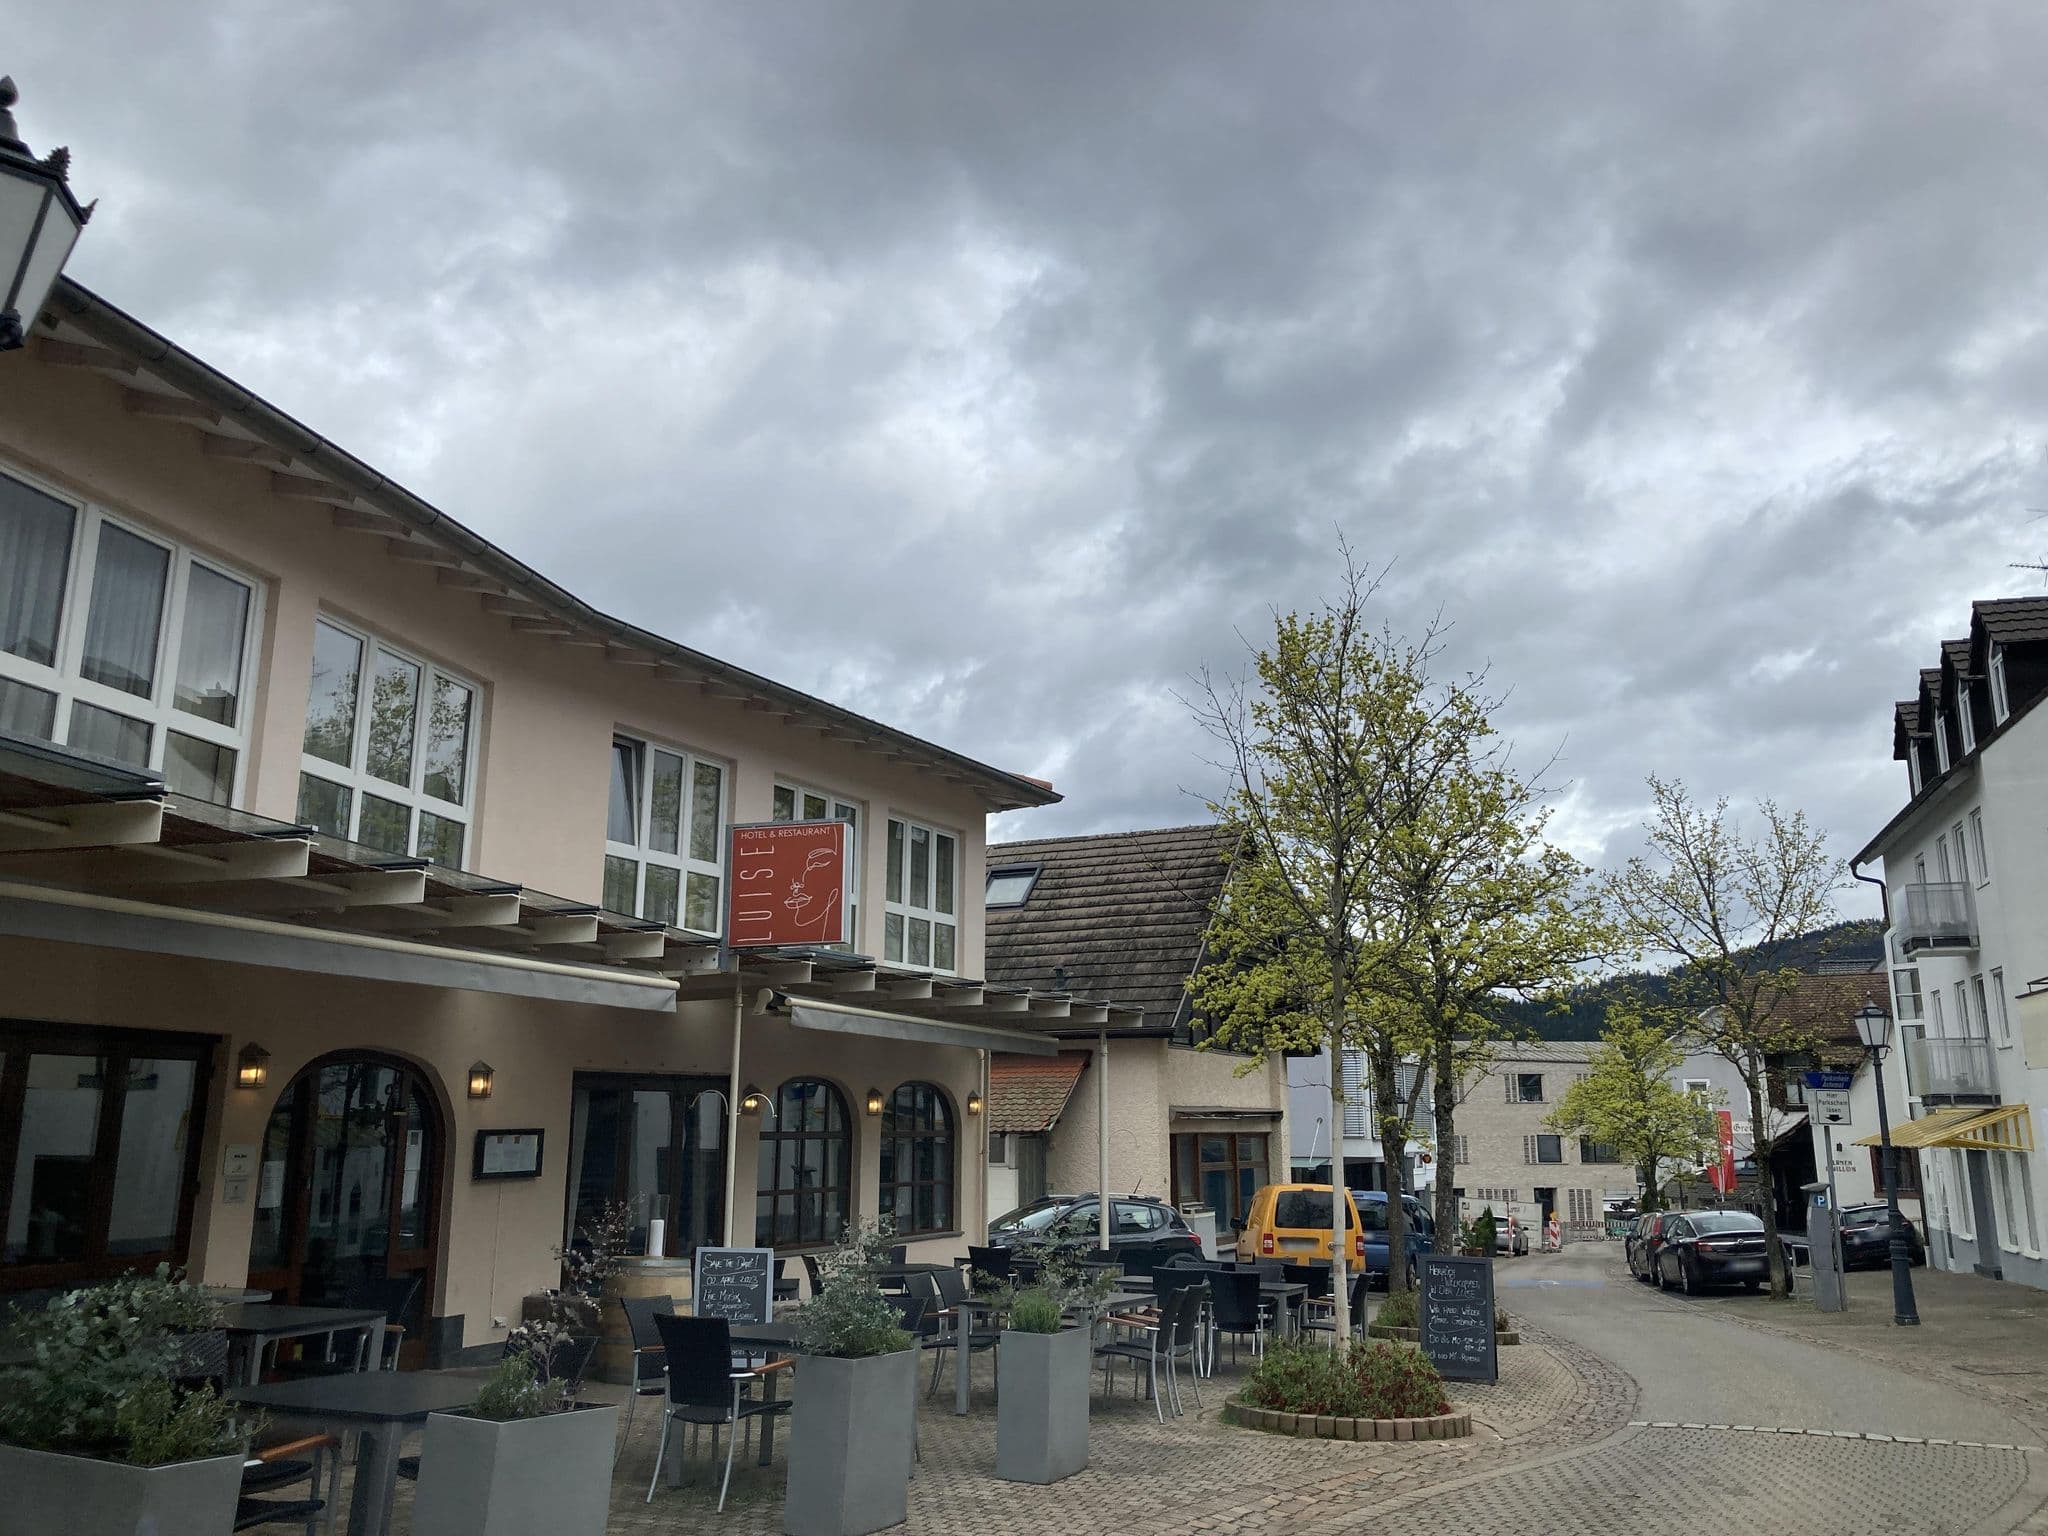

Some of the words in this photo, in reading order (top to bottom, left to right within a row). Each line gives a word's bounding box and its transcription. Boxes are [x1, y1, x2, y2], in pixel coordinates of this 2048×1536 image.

[769, 830, 776, 838] &
[778, 827, 830, 837] RESTAURANT
[736, 845, 774, 942] LUISE
[1817, 1195, 1825, 1207] P
